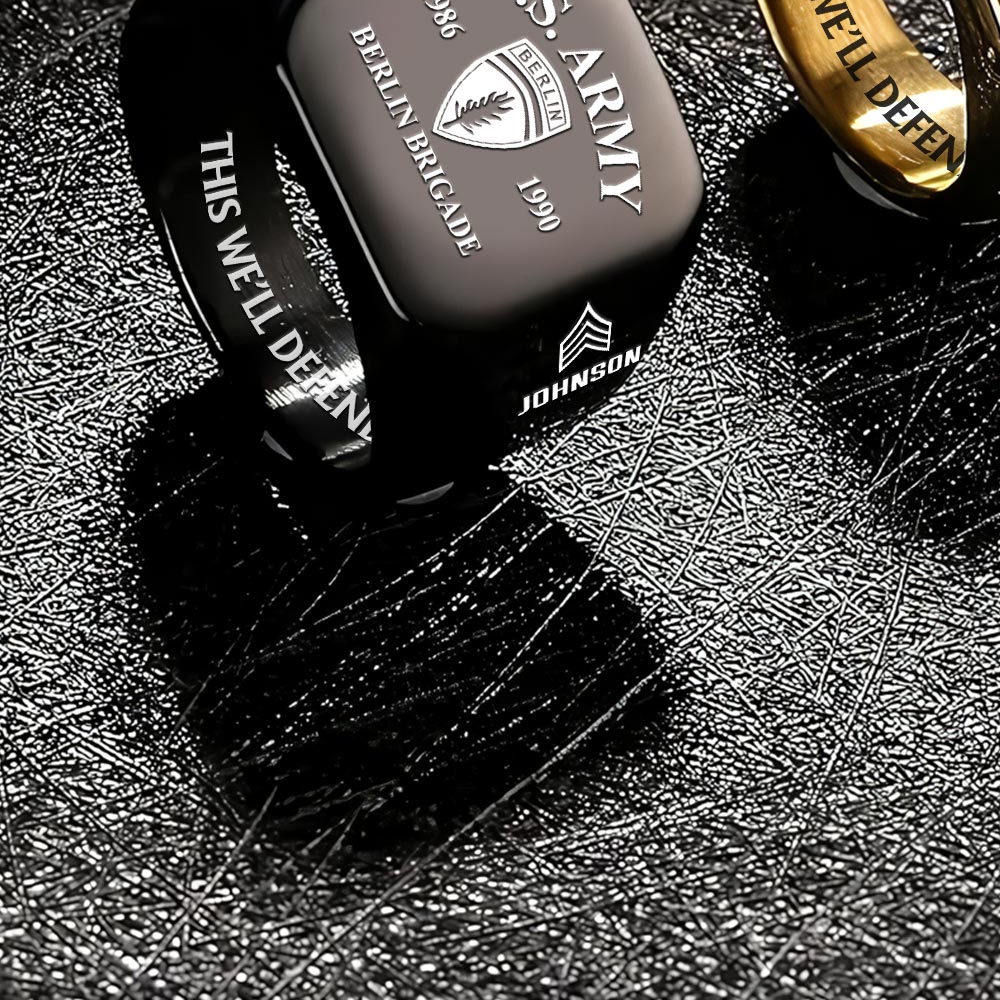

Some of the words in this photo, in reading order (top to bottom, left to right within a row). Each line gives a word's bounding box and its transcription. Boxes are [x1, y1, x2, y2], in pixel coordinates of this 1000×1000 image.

[518, 48, 563, 121] BERLIN
[558, 45, 645, 216] ARMY
[200, 130, 241, 224] THIS
[350, 23, 424, 133] BERLIN
[403, 131, 482, 259] BRIGADE
[516, 175, 562, 234] 1990
[216, 225, 283, 336] WE'LL
[518, 345, 642, 417] JOHNSON
